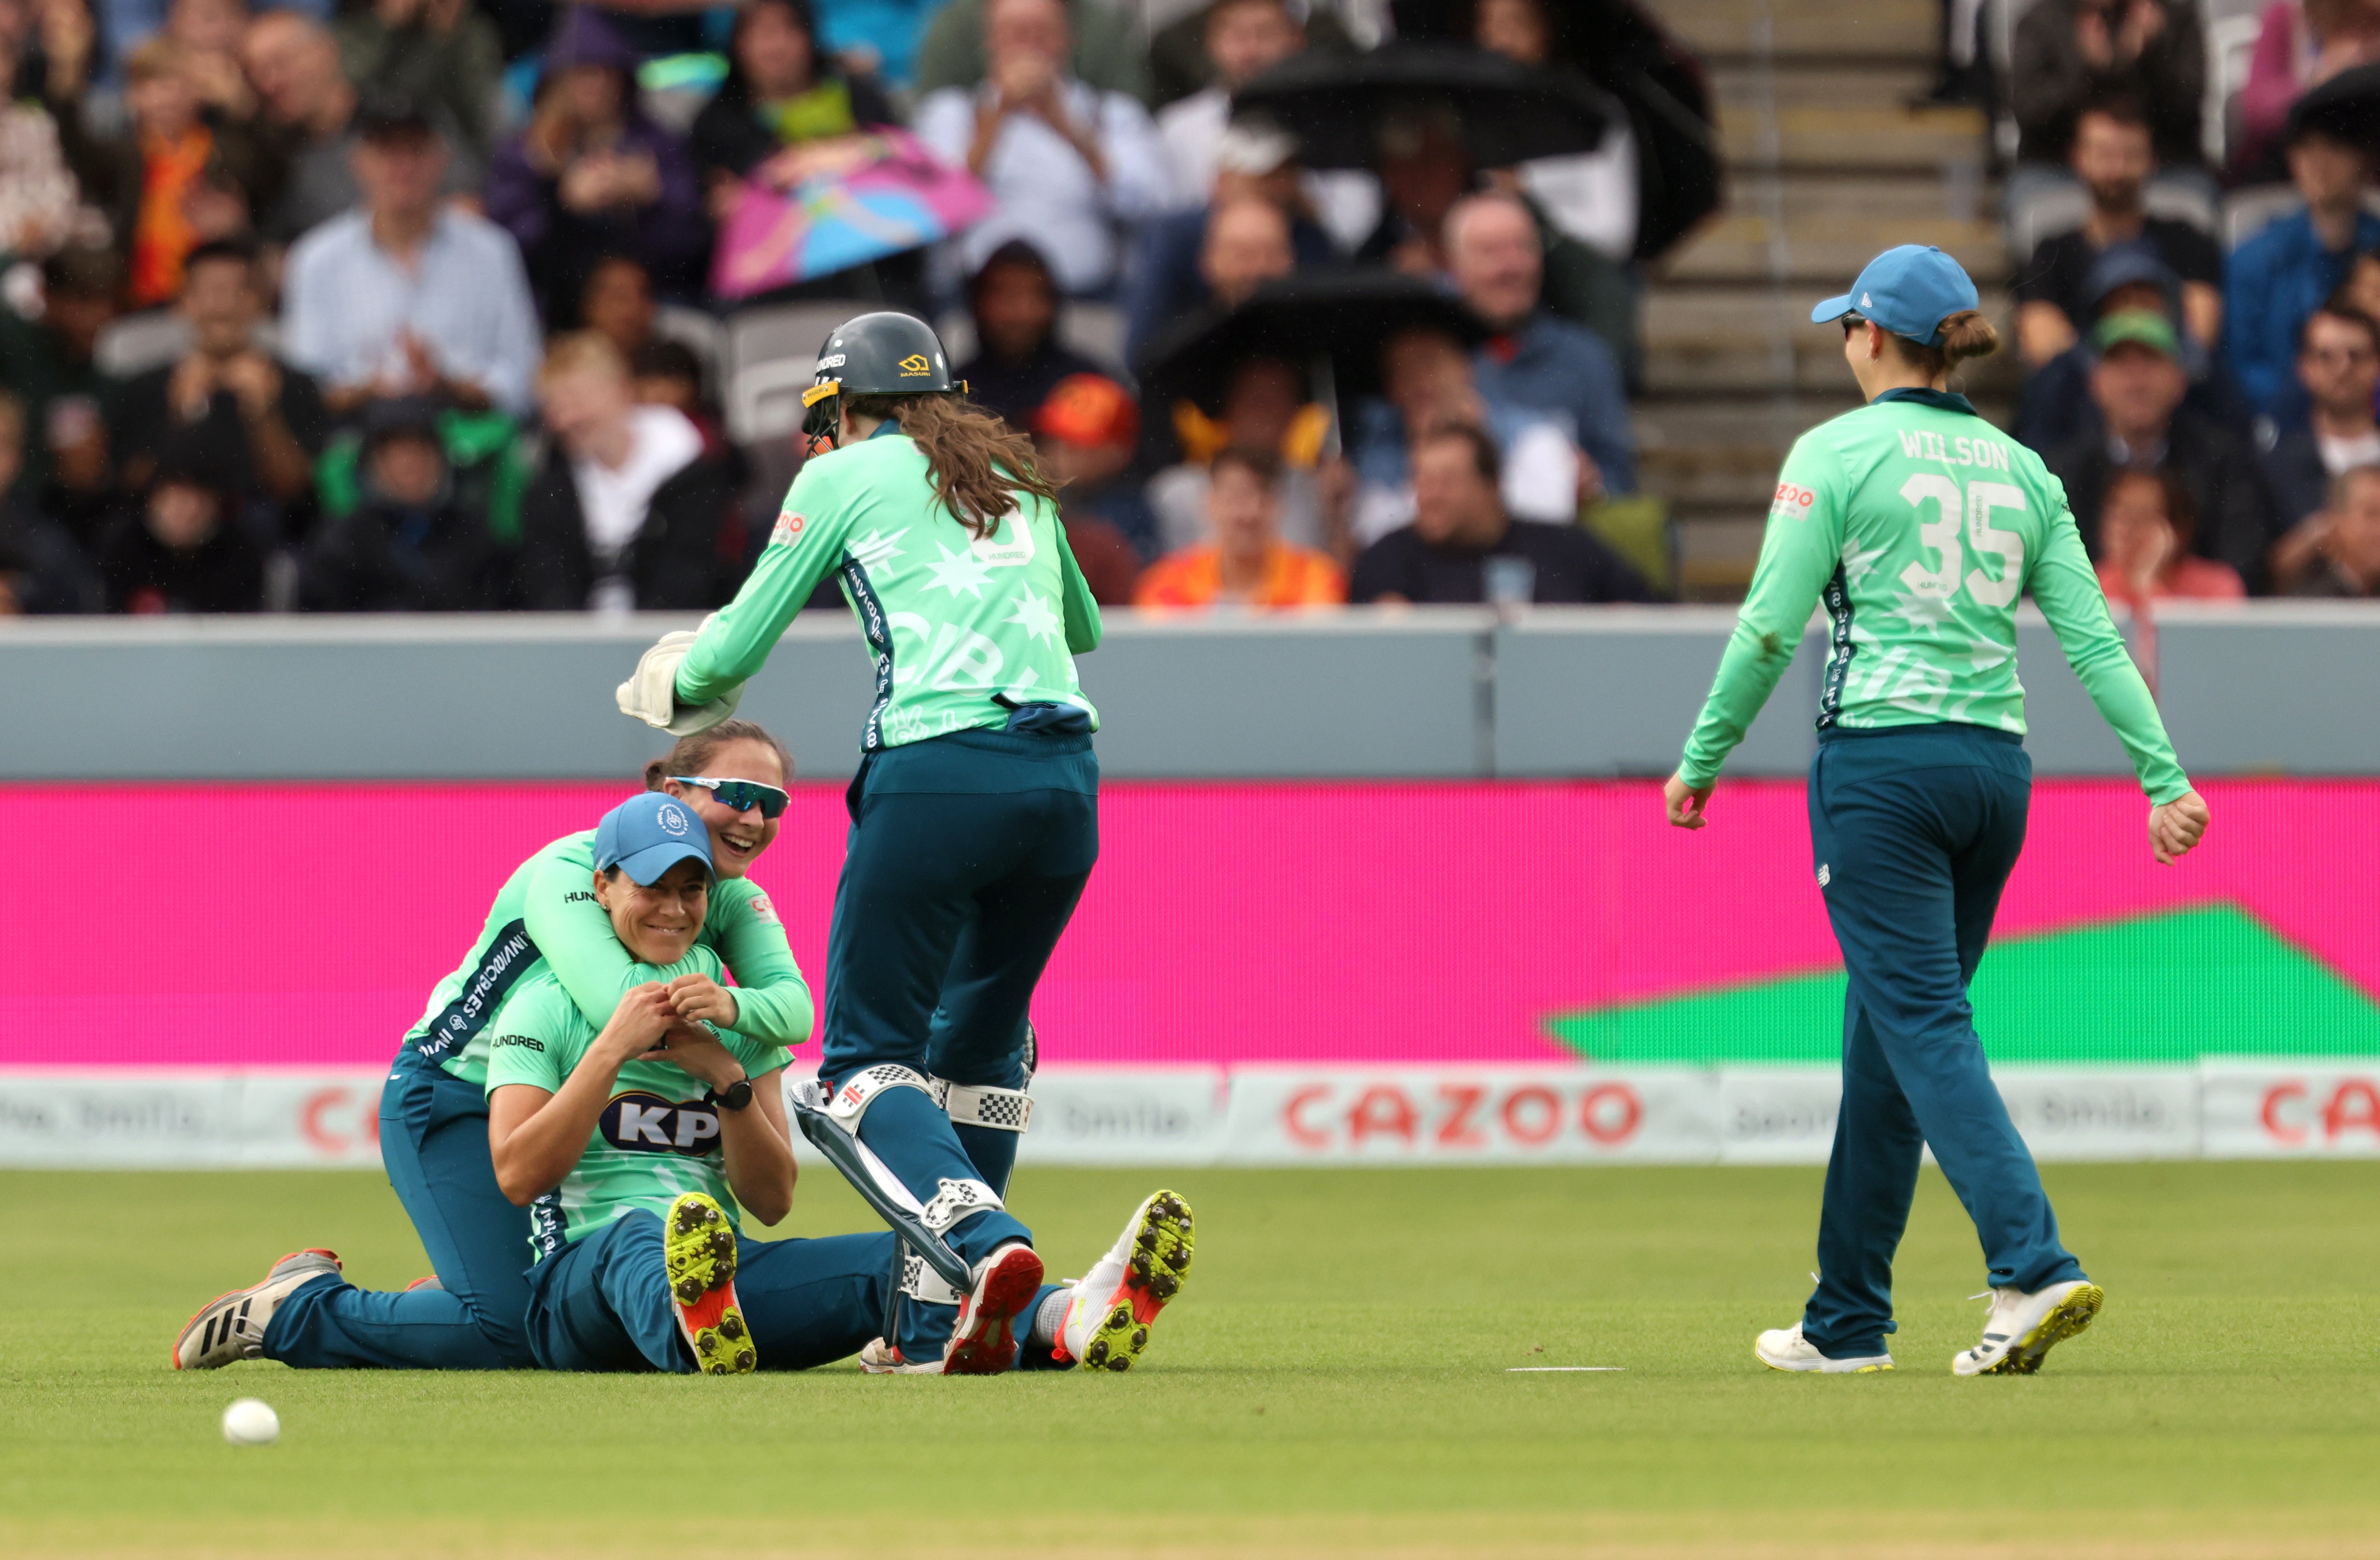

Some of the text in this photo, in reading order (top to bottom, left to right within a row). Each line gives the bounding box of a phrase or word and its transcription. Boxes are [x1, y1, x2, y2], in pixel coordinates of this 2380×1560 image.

[1898, 429, 2009, 472] WILSON
[989, 551, 1026, 560] HUNDRED
[1898, 472, 2026, 608] 35
[463, 934, 528, 1018] INVINCIBLES
[618, 1102, 719, 1147] KP
[1281, 1082, 1645, 1151] CAZOO
